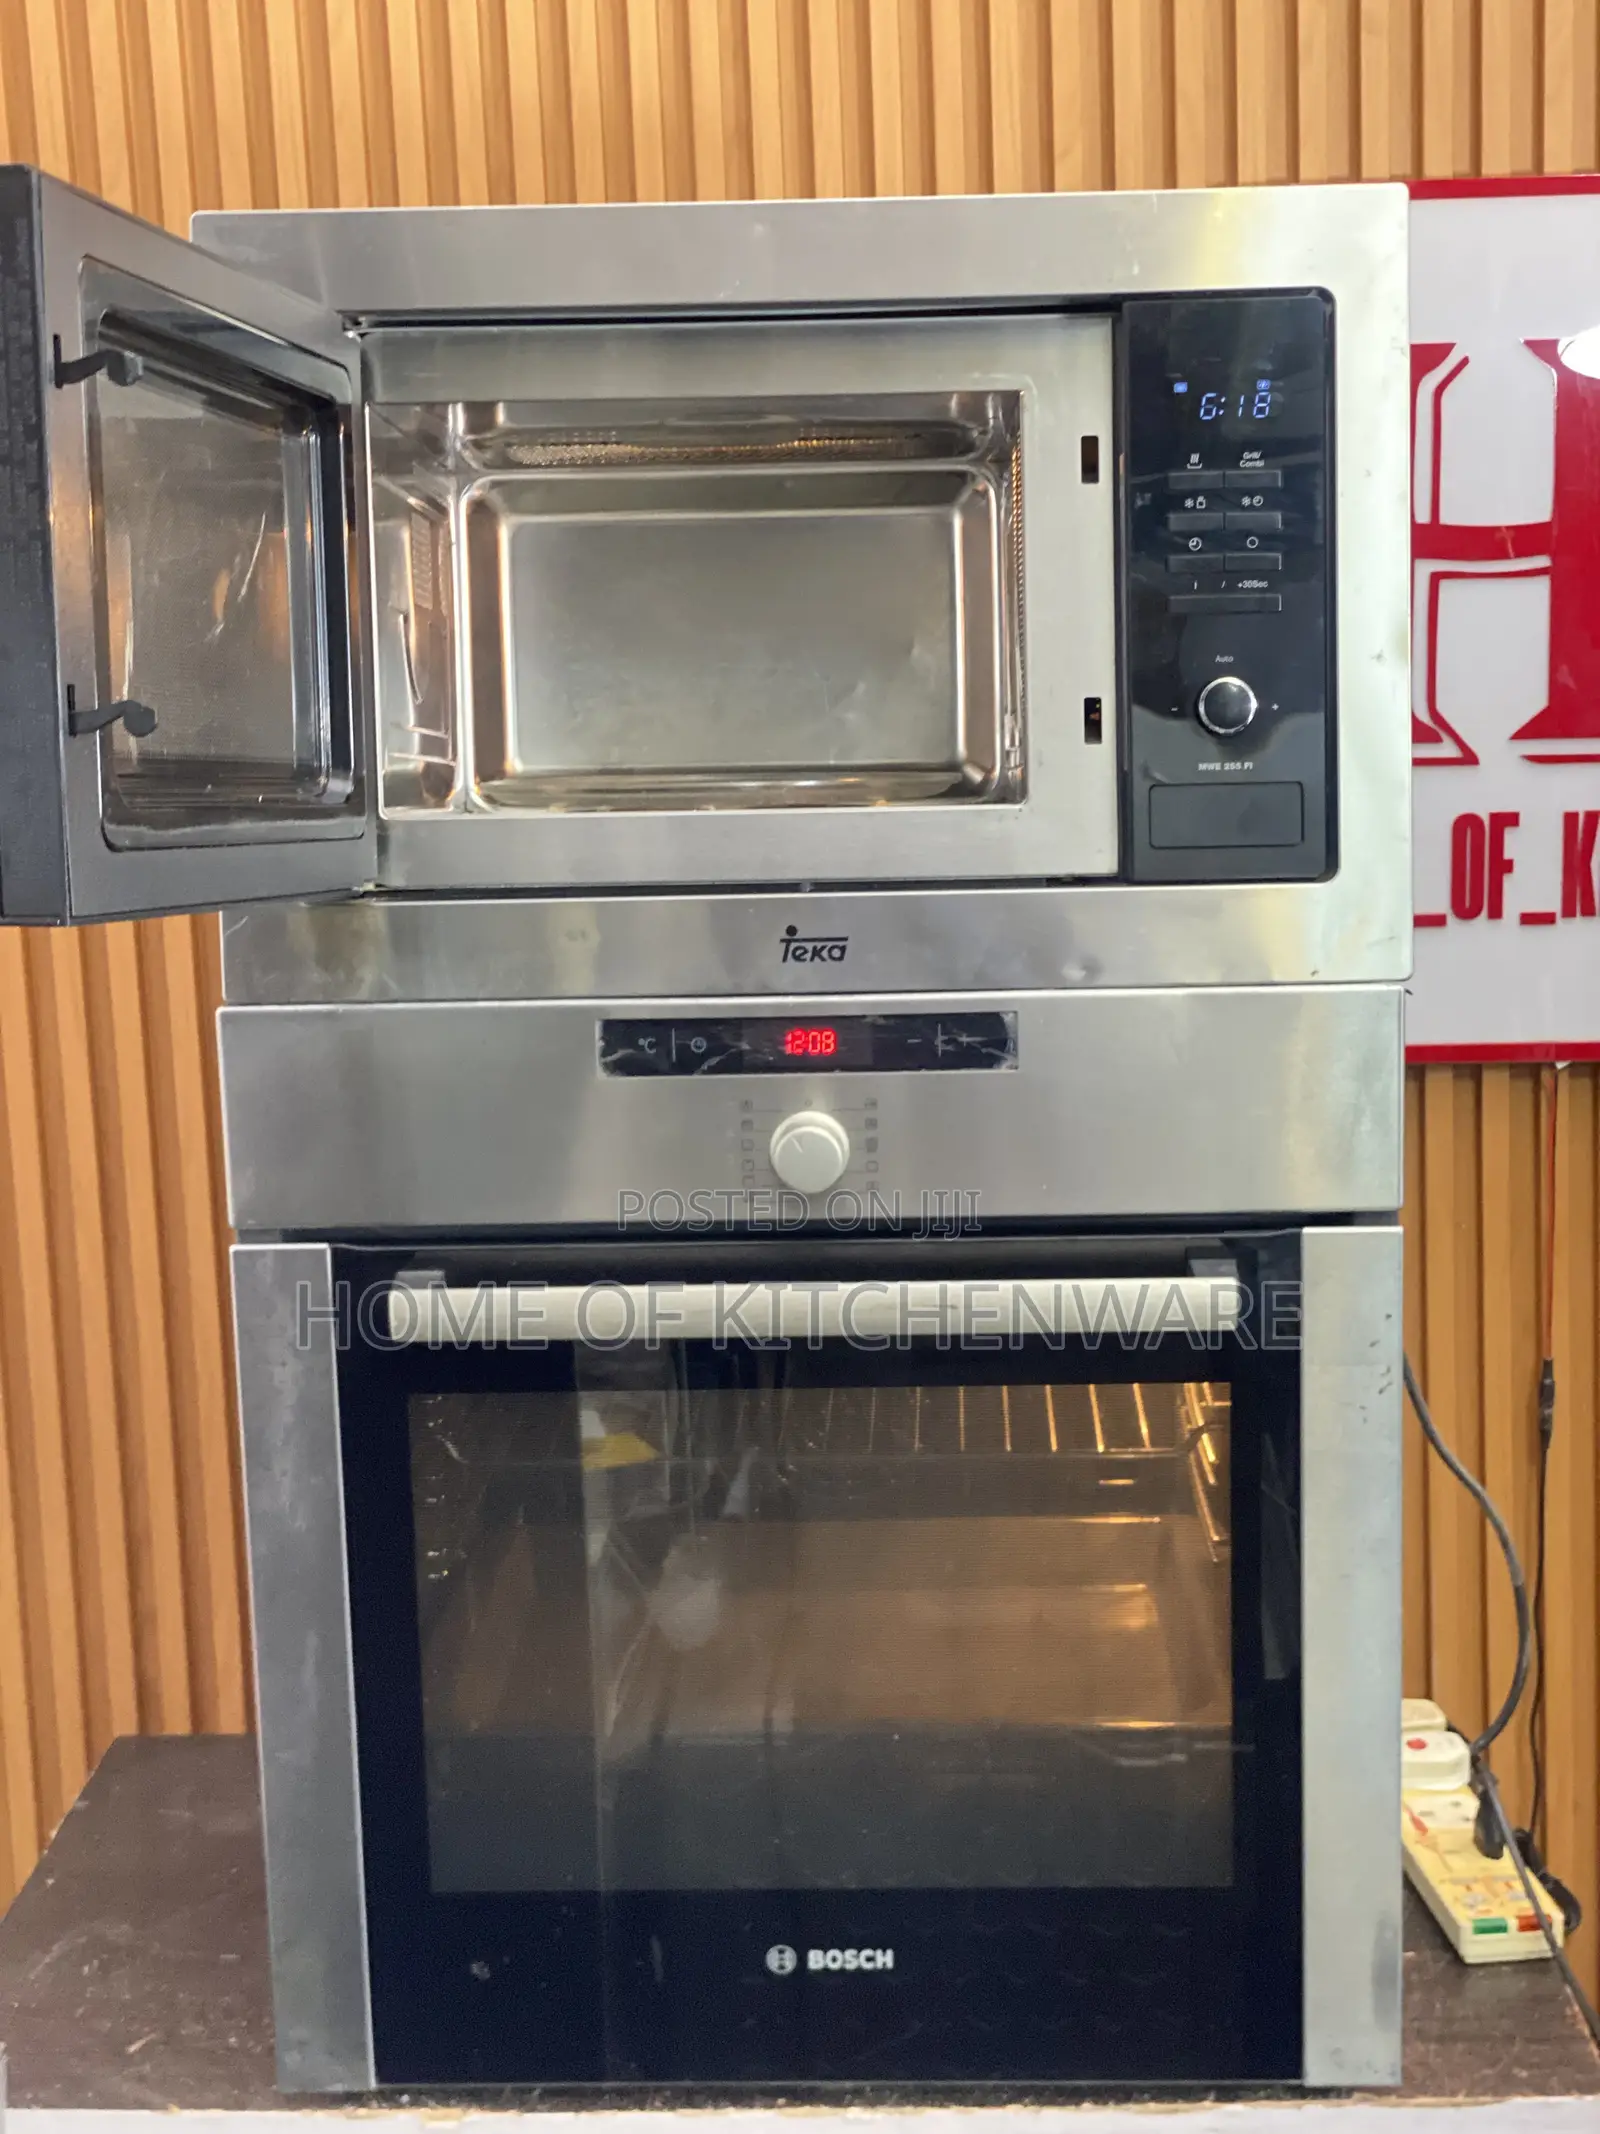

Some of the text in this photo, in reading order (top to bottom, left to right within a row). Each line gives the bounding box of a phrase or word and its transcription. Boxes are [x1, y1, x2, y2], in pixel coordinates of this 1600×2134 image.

[1200, 392, 1271, 420] 6:18
[1215, 655, 1233, 663] Auto
[807, 1949, 894, 1970] BOSCH
